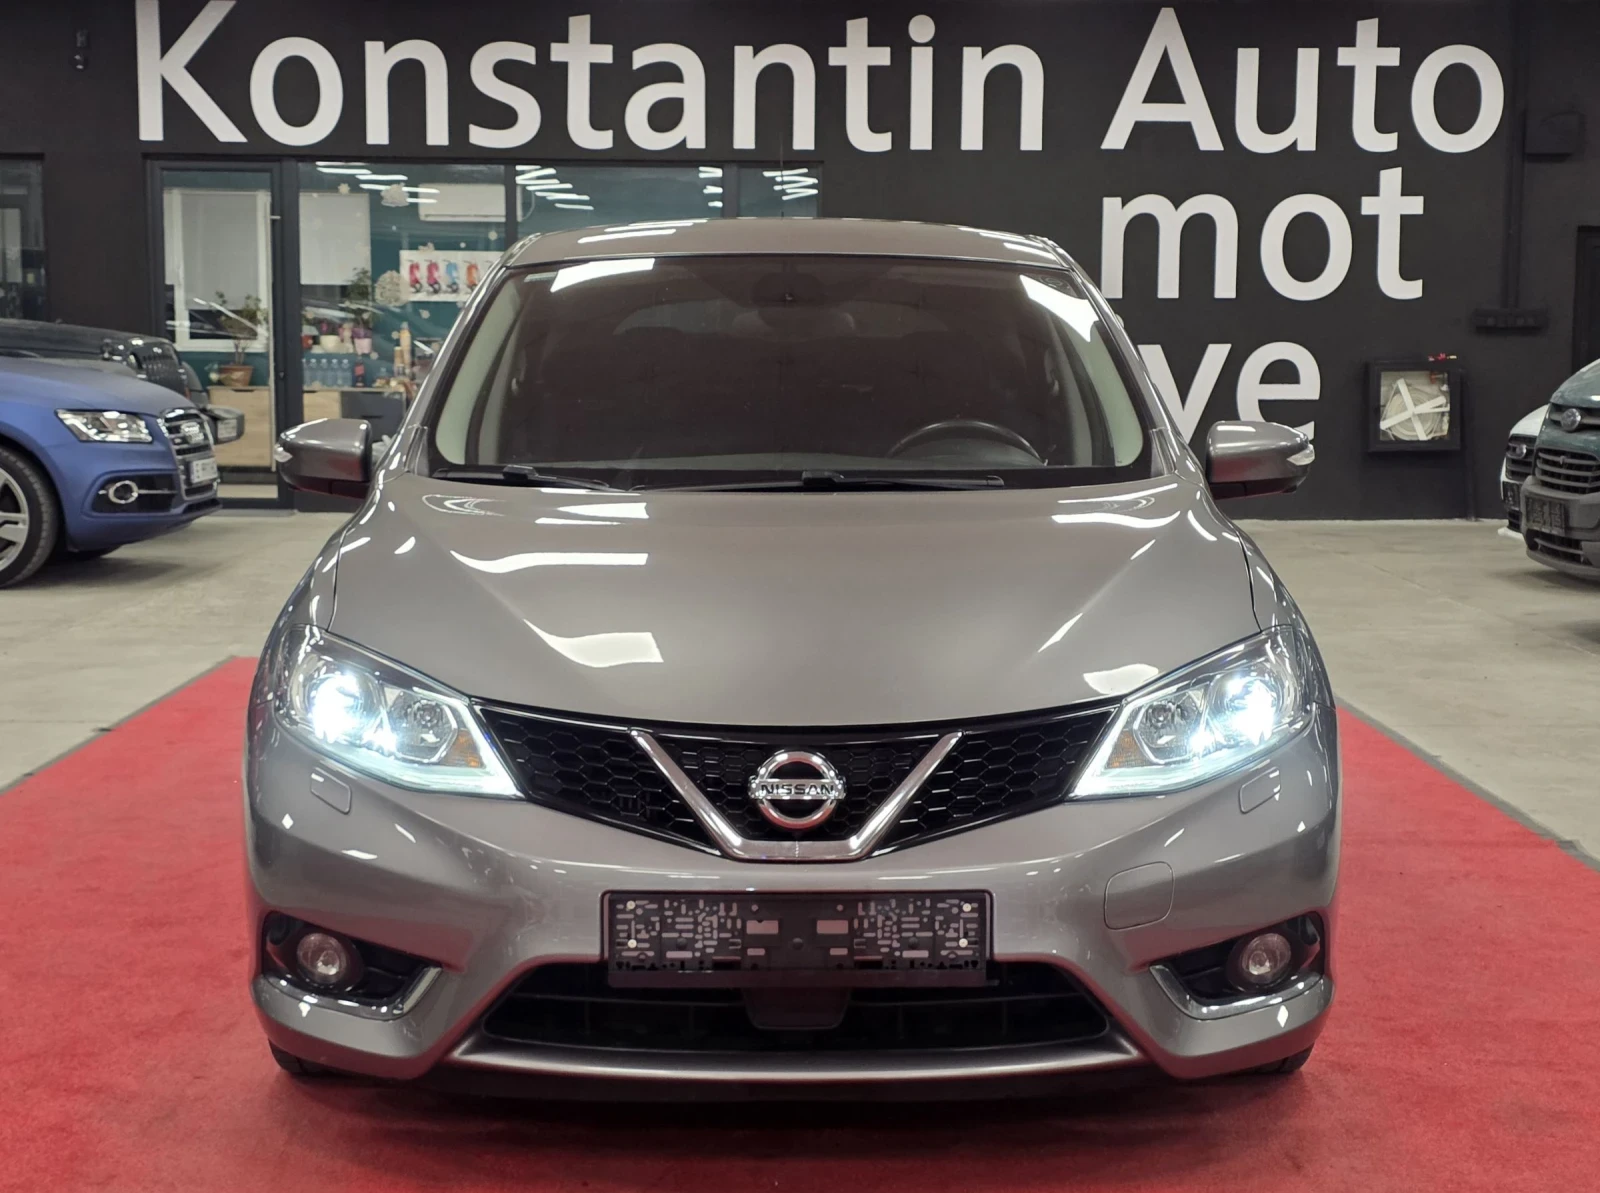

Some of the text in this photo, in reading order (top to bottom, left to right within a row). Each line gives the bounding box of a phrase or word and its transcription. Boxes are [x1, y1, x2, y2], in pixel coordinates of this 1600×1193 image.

[136, 0, 1505, 154] Konstantin Auto
[1100, 167, 1424, 302] mot
[760, 783, 835, 795] NISSAN
